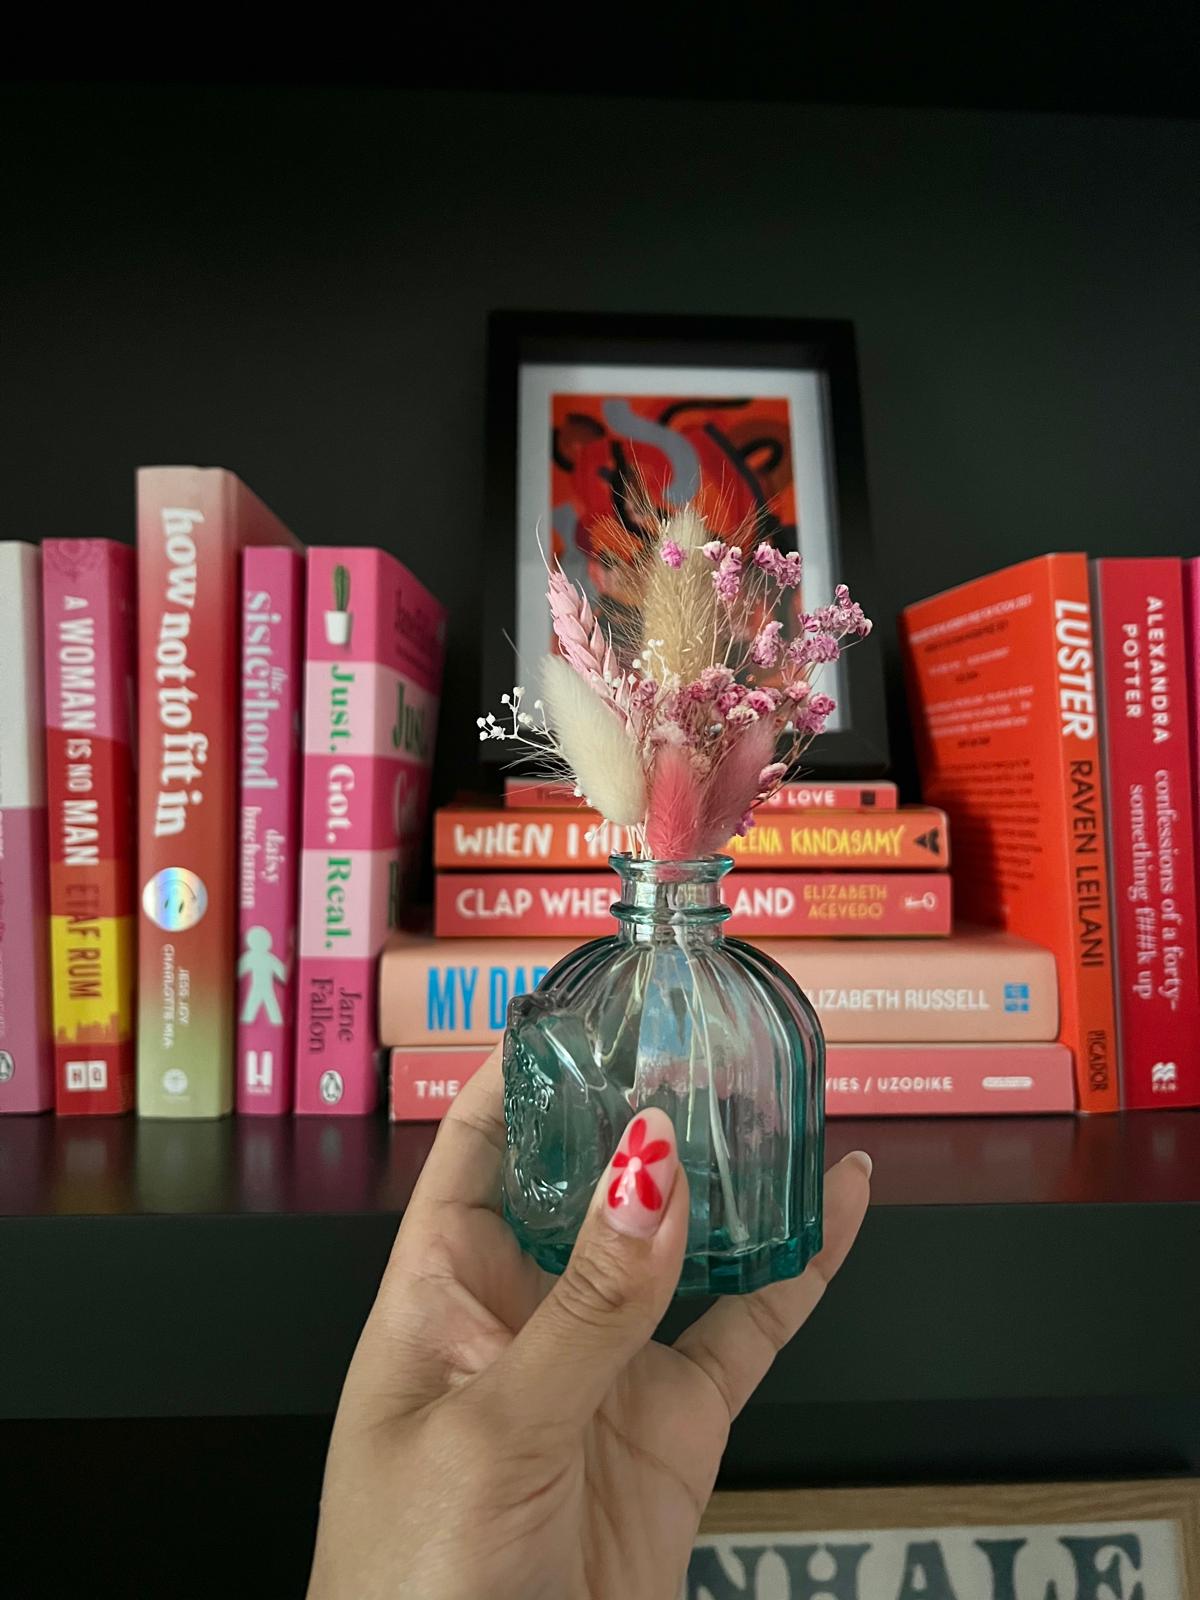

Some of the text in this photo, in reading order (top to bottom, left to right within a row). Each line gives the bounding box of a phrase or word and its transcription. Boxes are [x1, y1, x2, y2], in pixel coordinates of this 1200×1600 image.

[154, 507, 209, 838] how not to fit in
[242, 590, 282, 789] sisterhood
[1055, 599, 1096, 741] LUSTER
[1122, 623, 1143, 719] POTTER
[1146, 595, 1171, 744] ALEXANDRA
[59, 595, 99, 867] A WOMAN IS NO MAN
[324, 664, 355, 949] Just. Got. Real.
[787, 790, 835, 806] LOVE
[261, 829, 286, 884] daisy
[454, 823, 553, 858] WHEN
[567, 824, 579, 858] I
[791, 826, 905, 856] KANDASAMY
[1070, 760, 1104, 967] RAVEN LEILANI
[1128, 784, 1153, 902] something
[456, 888, 533, 919] CLAP
[803, 885, 887, 901] ELIZABETH
[808, 903, 884, 919] ACEVEDO
[1154, 769, 1184, 1011] confessions of a forty-
[65, 883, 102, 1000] ETAF RUM
[309, 978, 334, 1053] Fallon
[338, 987, 362, 1041] Jane
[427, 966, 478, 1031] MY
[905, 989, 989, 1010] RUSSELL
[1132, 971, 1153, 999] up
[414, 1080, 460, 1099] THE
[878, 1077, 953, 1092] UZODIKE
[1088, 1030, 1108, 1091] PICADOR
